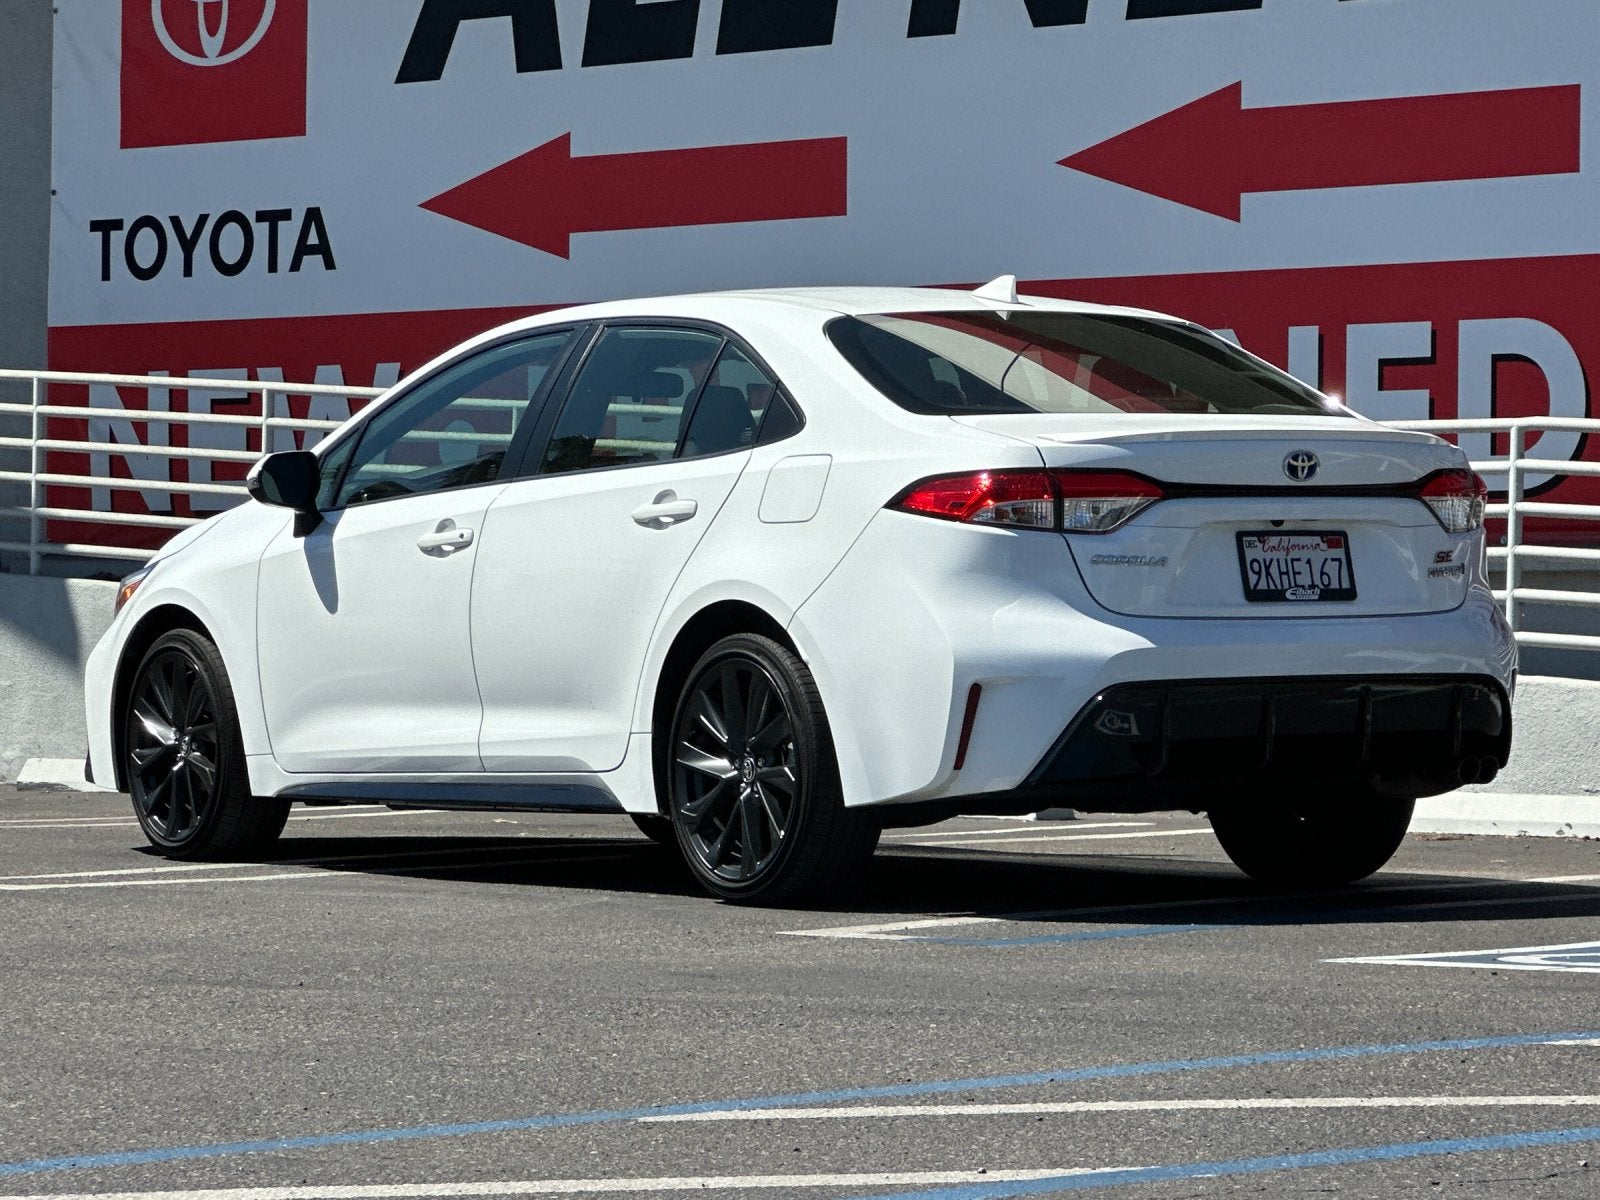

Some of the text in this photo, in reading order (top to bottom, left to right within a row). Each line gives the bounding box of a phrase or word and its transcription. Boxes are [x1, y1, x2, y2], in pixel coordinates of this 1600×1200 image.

[90, 206, 337, 282] TOYOTA
[1245, 539, 1258, 549] DEC
[1261, 537, 1327, 557] California
[1090, 554, 1169, 567] COROLLA
[1433, 550, 1454, 564] SE
[1249, 557, 1343, 589] 9KHE167
